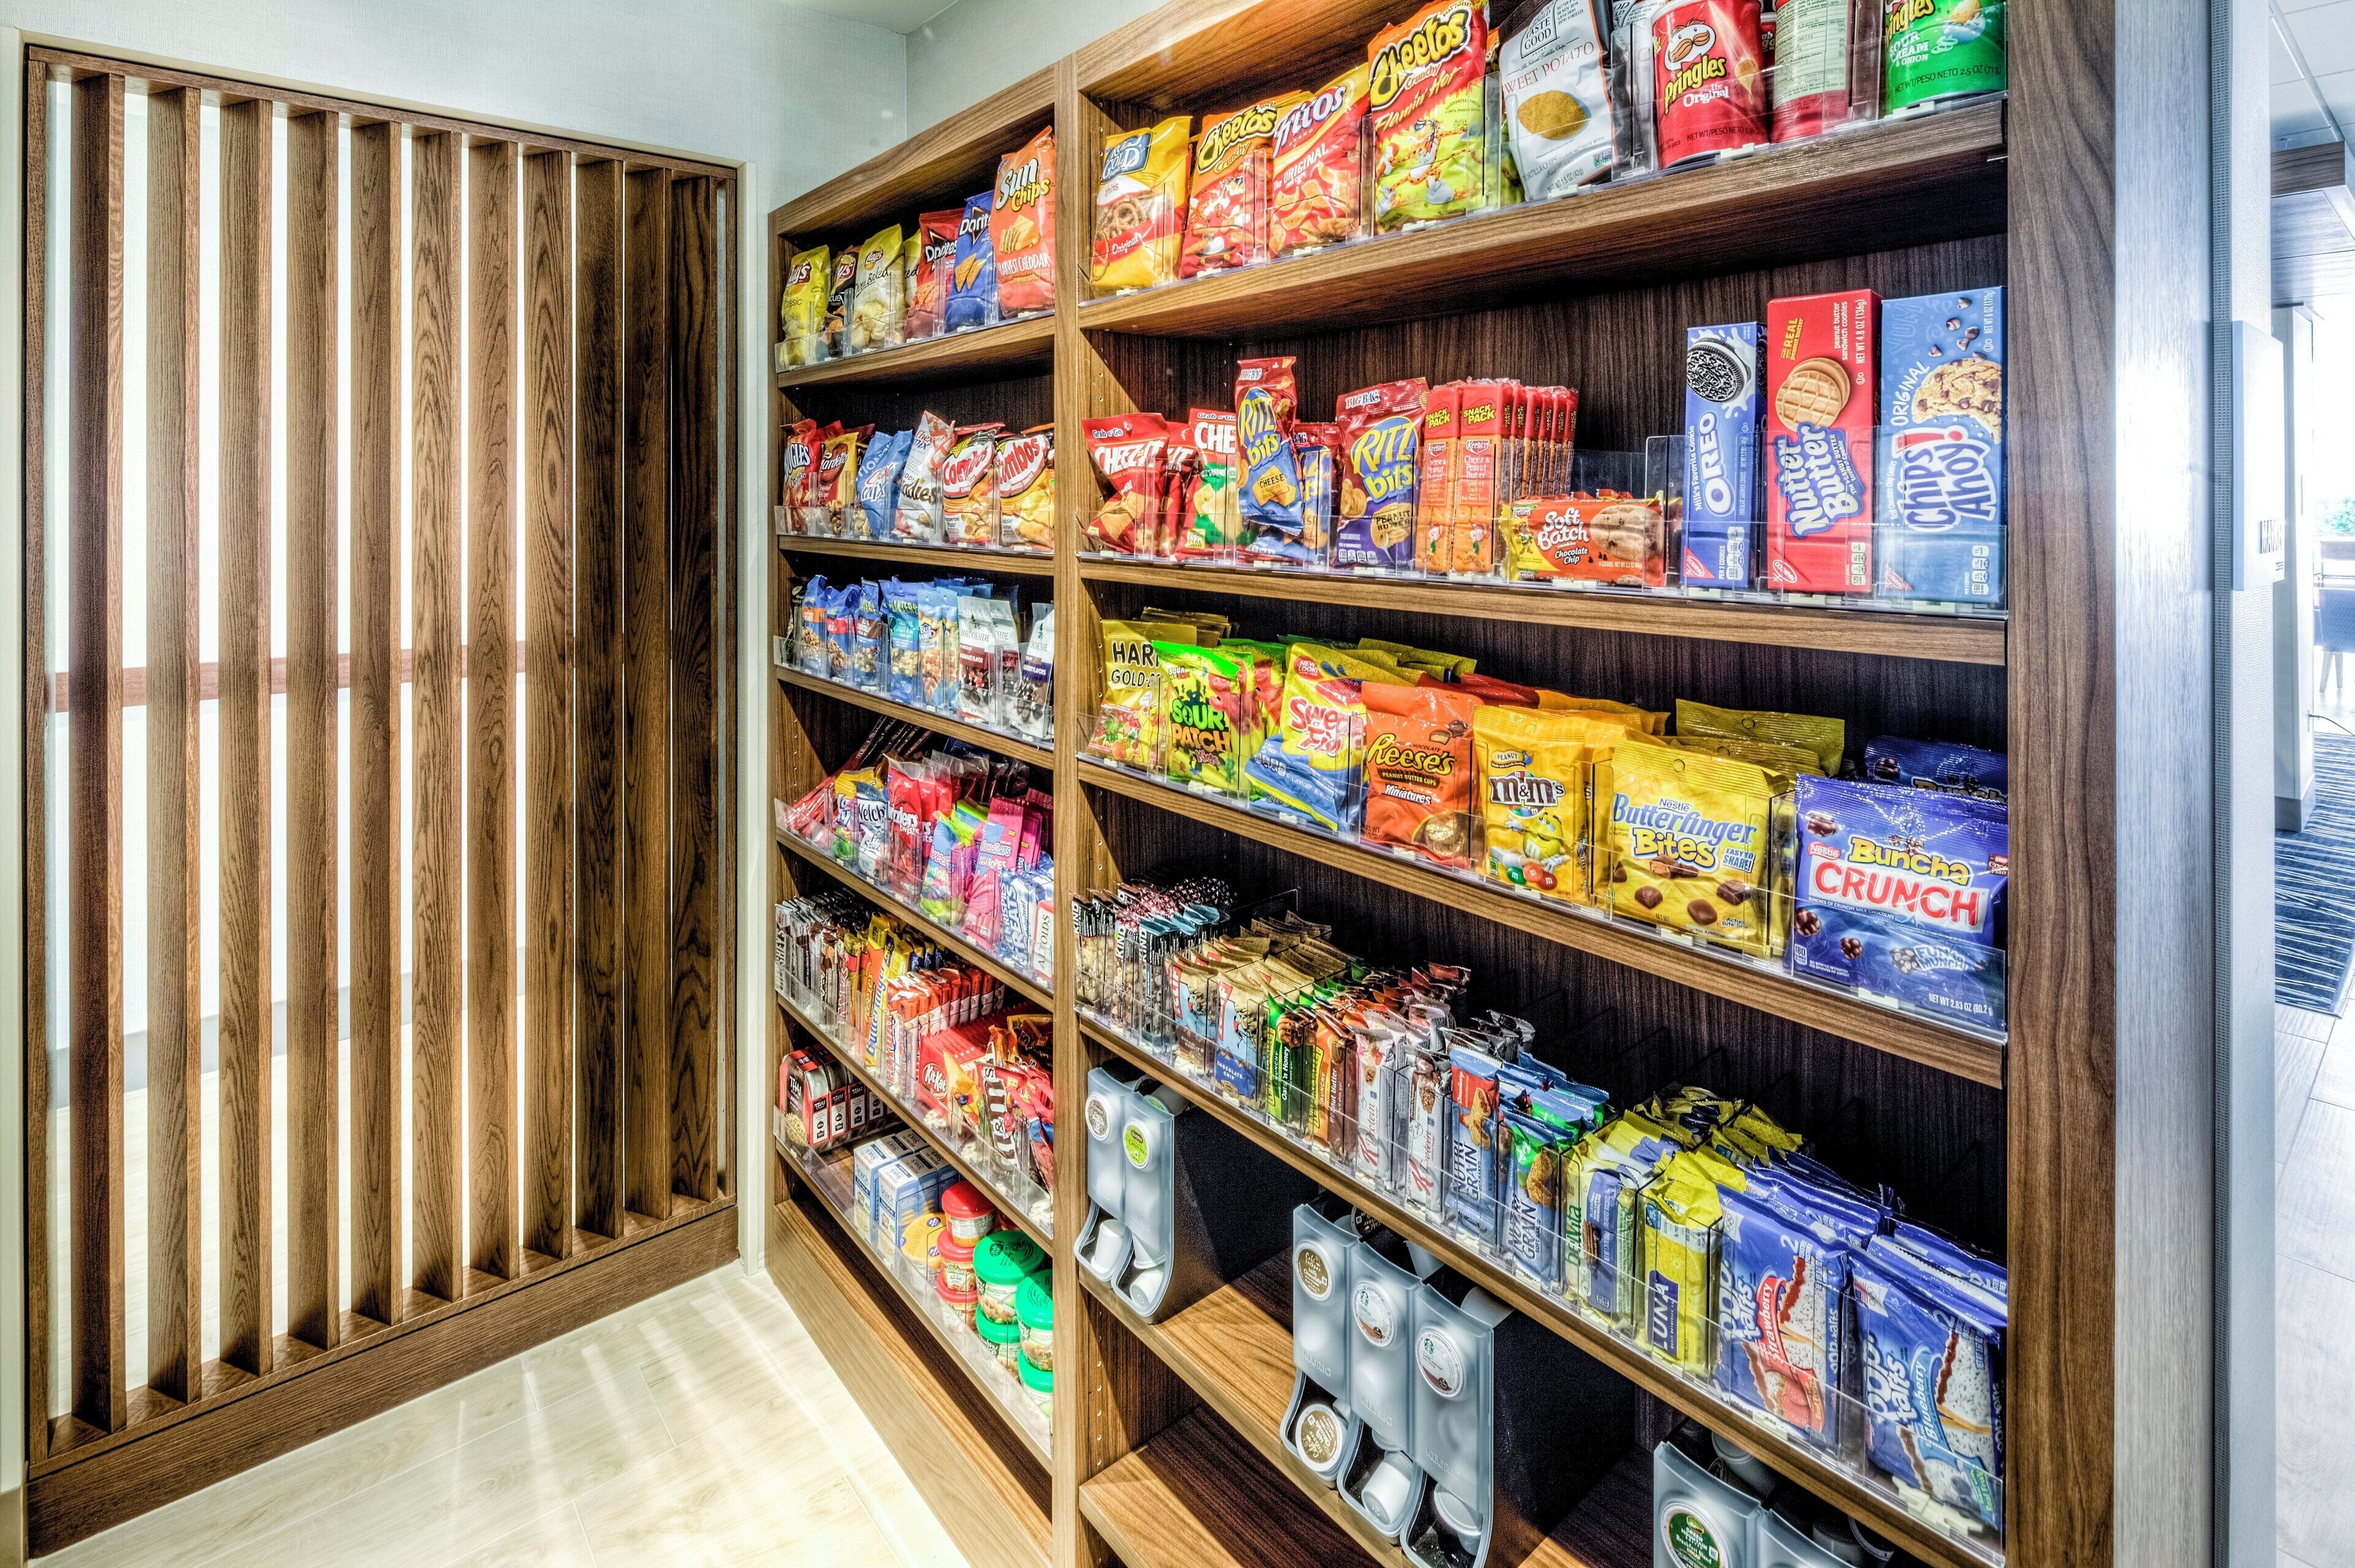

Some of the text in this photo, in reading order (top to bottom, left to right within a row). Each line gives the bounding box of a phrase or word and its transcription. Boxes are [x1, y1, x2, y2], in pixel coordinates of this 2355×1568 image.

[1524, 28, 1552, 50] GOOD
[1890, 31, 1920, 55] SOUR
[1891, 40, 1929, 63] CREAM
[1370, 9, 1469, 109] Cheetos
[1541, 41, 1595, 77] POTATO
[1901, 53, 1929, 65] ONION
[1937, 65, 1983, 80] NETO 2.5 OZ
[1404, 64, 1441, 90] Crunchy
[1428, 67, 1463, 98] Hot
[1664, 55, 1726, 115] Pringles
[1711, 83, 1723, 92] the
[1683, 86, 1729, 107] Original
[1273, 86, 1347, 159] Fritos
[1687, 132, 1699, 141] NET
[1199, 109, 1277, 171] Cheetos
[1214, 141, 1252, 174] Crunchy
[1284, 142, 1330, 182] ORIGINAL
[995, 157, 1040, 212] Sun
[1011, 177, 1051, 212] Chips
[1105, 182, 1119, 196] thins
[1111, 233, 1139, 254] Original
[1019, 253, 1050, 271] CHEDDAR
[1984, 290, 1995, 334] NET WT OZ (170g)
[1783, 318, 1799, 349] REAL
[1794, 317, 1803, 338] butter
[1855, 299, 1867, 364] NET WT 4.8 OZ (136g)
[1241, 370, 1251, 380] BIG
[1346, 391, 1379, 409] BIG BAG
[1890, 361, 1931, 426] ORIGINAL
[1239, 399, 1277, 446] RITZ
[1426, 408, 1447, 422] SNACK
[1428, 413, 1451, 430] PACK
[1463, 403, 1492, 418] SNACK
[1468, 410, 1496, 426] PACK
[916, 430, 935, 443] Chex
[1247, 432, 1281, 467] bits
[1354, 423, 1413, 475] RITZ
[1830, 434, 1842, 459] BUTTER
[1465, 455, 1485, 464] Cheese
[1690, 453, 1699, 486] Favorite
[1699, 411, 1733, 514] OREO
[1802, 426, 1858, 519] Butter
[1260, 473, 1284, 489] CHEESE
[1365, 464, 1412, 499] bits
[1779, 438, 1829, 535] Nutter
[1904, 447, 1956, 529] Chips
[1544, 507, 1580, 532] Soft
[1537, 521, 1590, 551] Batch
[1554, 547, 1589, 560] Chocolate
[1563, 555, 1580, 565] Chip
[961, 629, 990, 643] BROOKSIDE
[1298, 665, 1319, 674] LOOK!
[1171, 698, 1225, 731] SOUR
[1171, 723, 1230, 752] PATCH
[1195, 749, 1220, 766] Kids
[1368, 733, 1455, 776] Reese's
[1382, 771, 1436, 786] PEANUT BUTTER CUPS
[1384, 784, 1432, 805] Miniatures
[899, 825, 920, 835] twists
[1613, 793, 1758, 846] Butterfinger
[1633, 827, 1716, 868] Bites
[988, 857, 1008, 868] ROPES
[1722, 854, 1753, 871] SHARE!
[1849, 838, 1970, 886] Buncha
[1809, 897, 1827, 906] BUNCHES
[1834, 903, 1856, 912] CRUNCHY
[1868, 909, 1895, 920] CHOCOLATE
[1814, 862, 1980, 927] CRUNCH
[1038, 914, 1051, 969] ALTOIDS
[1116, 926, 1126, 959] KIND
[1139, 928, 1148, 963] KIND
[1794, 945, 1806, 956] 180
[1917, 946, 1949, 959] FUN
[1170, 969, 1180, 1006] CLIF
[866, 968, 884, 1058] Butterfinger
[1929, 993, 1972, 1012] NET WT 2.83 OZ
[1217, 1060, 1244, 1080] CHOCOLATE
[1282, 1046, 1290, 1071] Honey
[789, 1075, 803, 1096] THAI
[1223, 1070, 1235, 1080] CHIP
[1457, 1072, 1465, 1105] Strawberry
[814, 1100, 825, 1109] THAI
[1328, 1095, 1337, 1123] Peanut
[1366, 1103, 1376, 1145] Protein
[1357, 1132, 1379, 1166] K
[1409, 1158, 1434, 1196] K
[1453, 1139, 1466, 1195] NUTRI
[1463, 1143, 1479, 1201] GRAIN
[1520, 1201, 1537, 1260] GRAIN
[1564, 1204, 1582, 1267] belVita
[1780, 1234, 1799, 1253] 2
[1798, 1240, 1807, 1258] TOASTER
[1303, 1269, 1322, 1285] Chocolate
[1308, 1268, 1317, 1277] Milk
[1652, 1282, 1669, 1351] LUNA
[1737, 1277, 1760, 1339] tarts
[1761, 1282, 1782, 1362] Strawberry
[1303, 1348, 1331, 1379] KEURIG
[1886, 1353, 1914, 1420] tarts
[1360, 1394, 1393, 1428] KEURIG
[1915, 1360, 1940, 1442] Blueberry
[1425, 1446, 1461, 1482] KEURIG
[1984, 1493, 1994, 1512] Real
[1680, 1528, 1708, 1551] MOUNTAIN
[1686, 1527, 1704, 1542] GREEN
[1698, 1550, 1712, 1564] Blend
